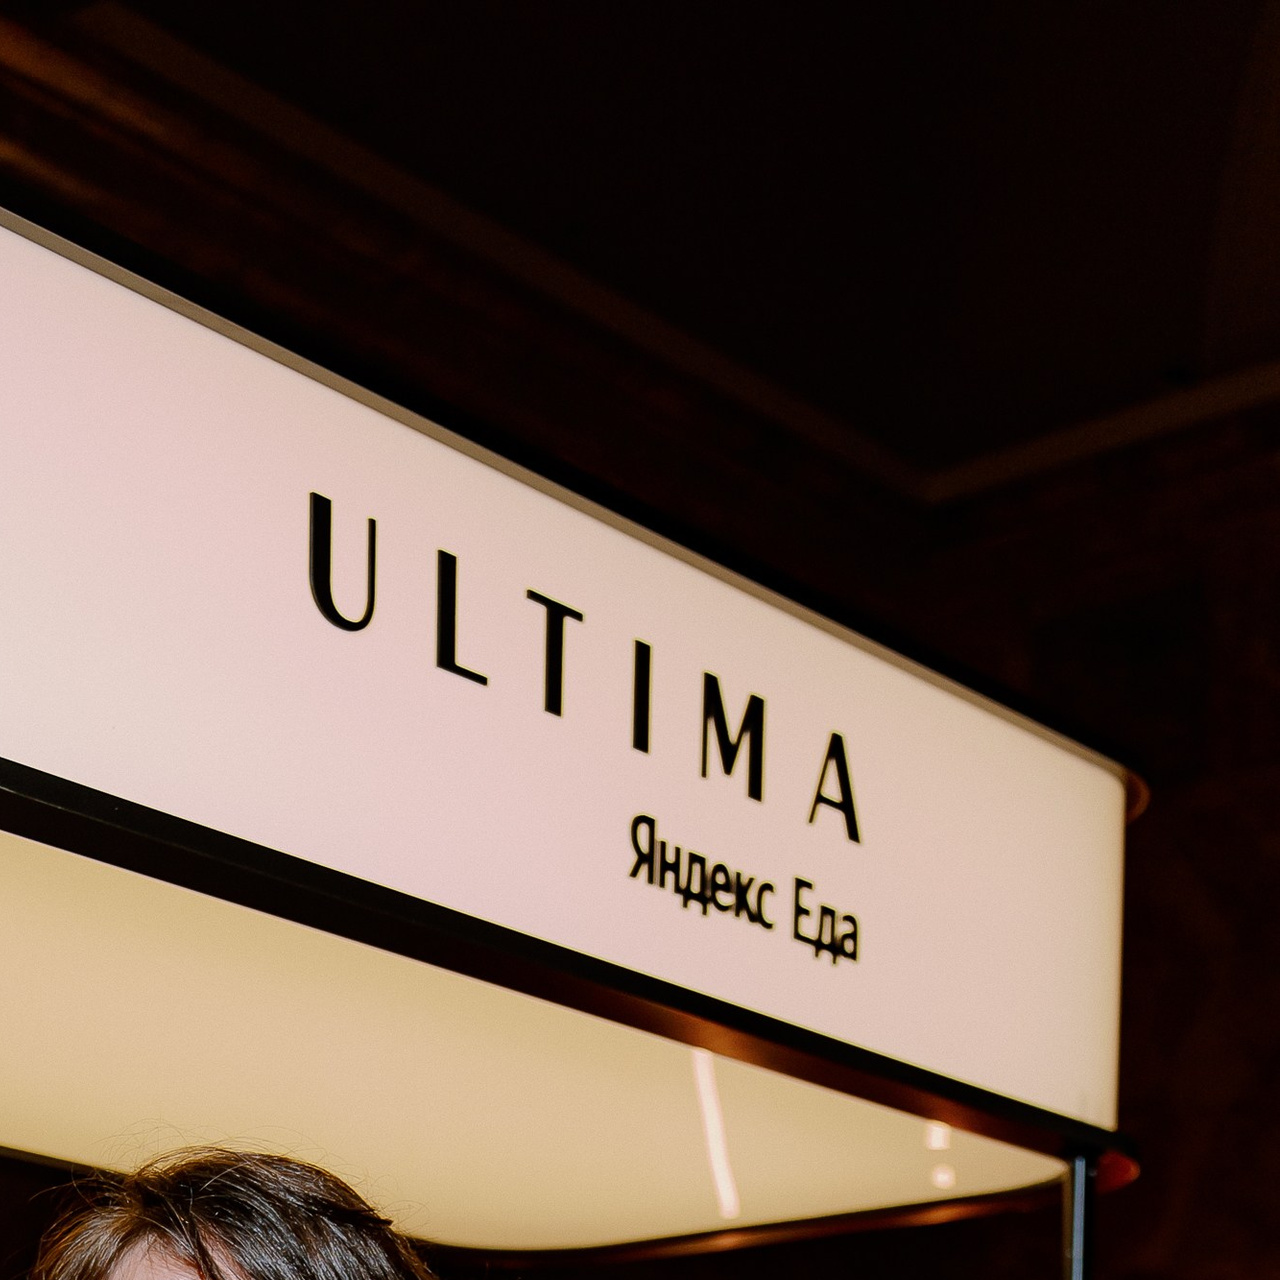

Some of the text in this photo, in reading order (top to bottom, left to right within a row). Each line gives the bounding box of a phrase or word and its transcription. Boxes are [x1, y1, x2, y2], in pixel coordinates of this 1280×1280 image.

[309, 491, 861, 844] ULTIMA
[630, 814, 859, 965] Яндекс Еда
